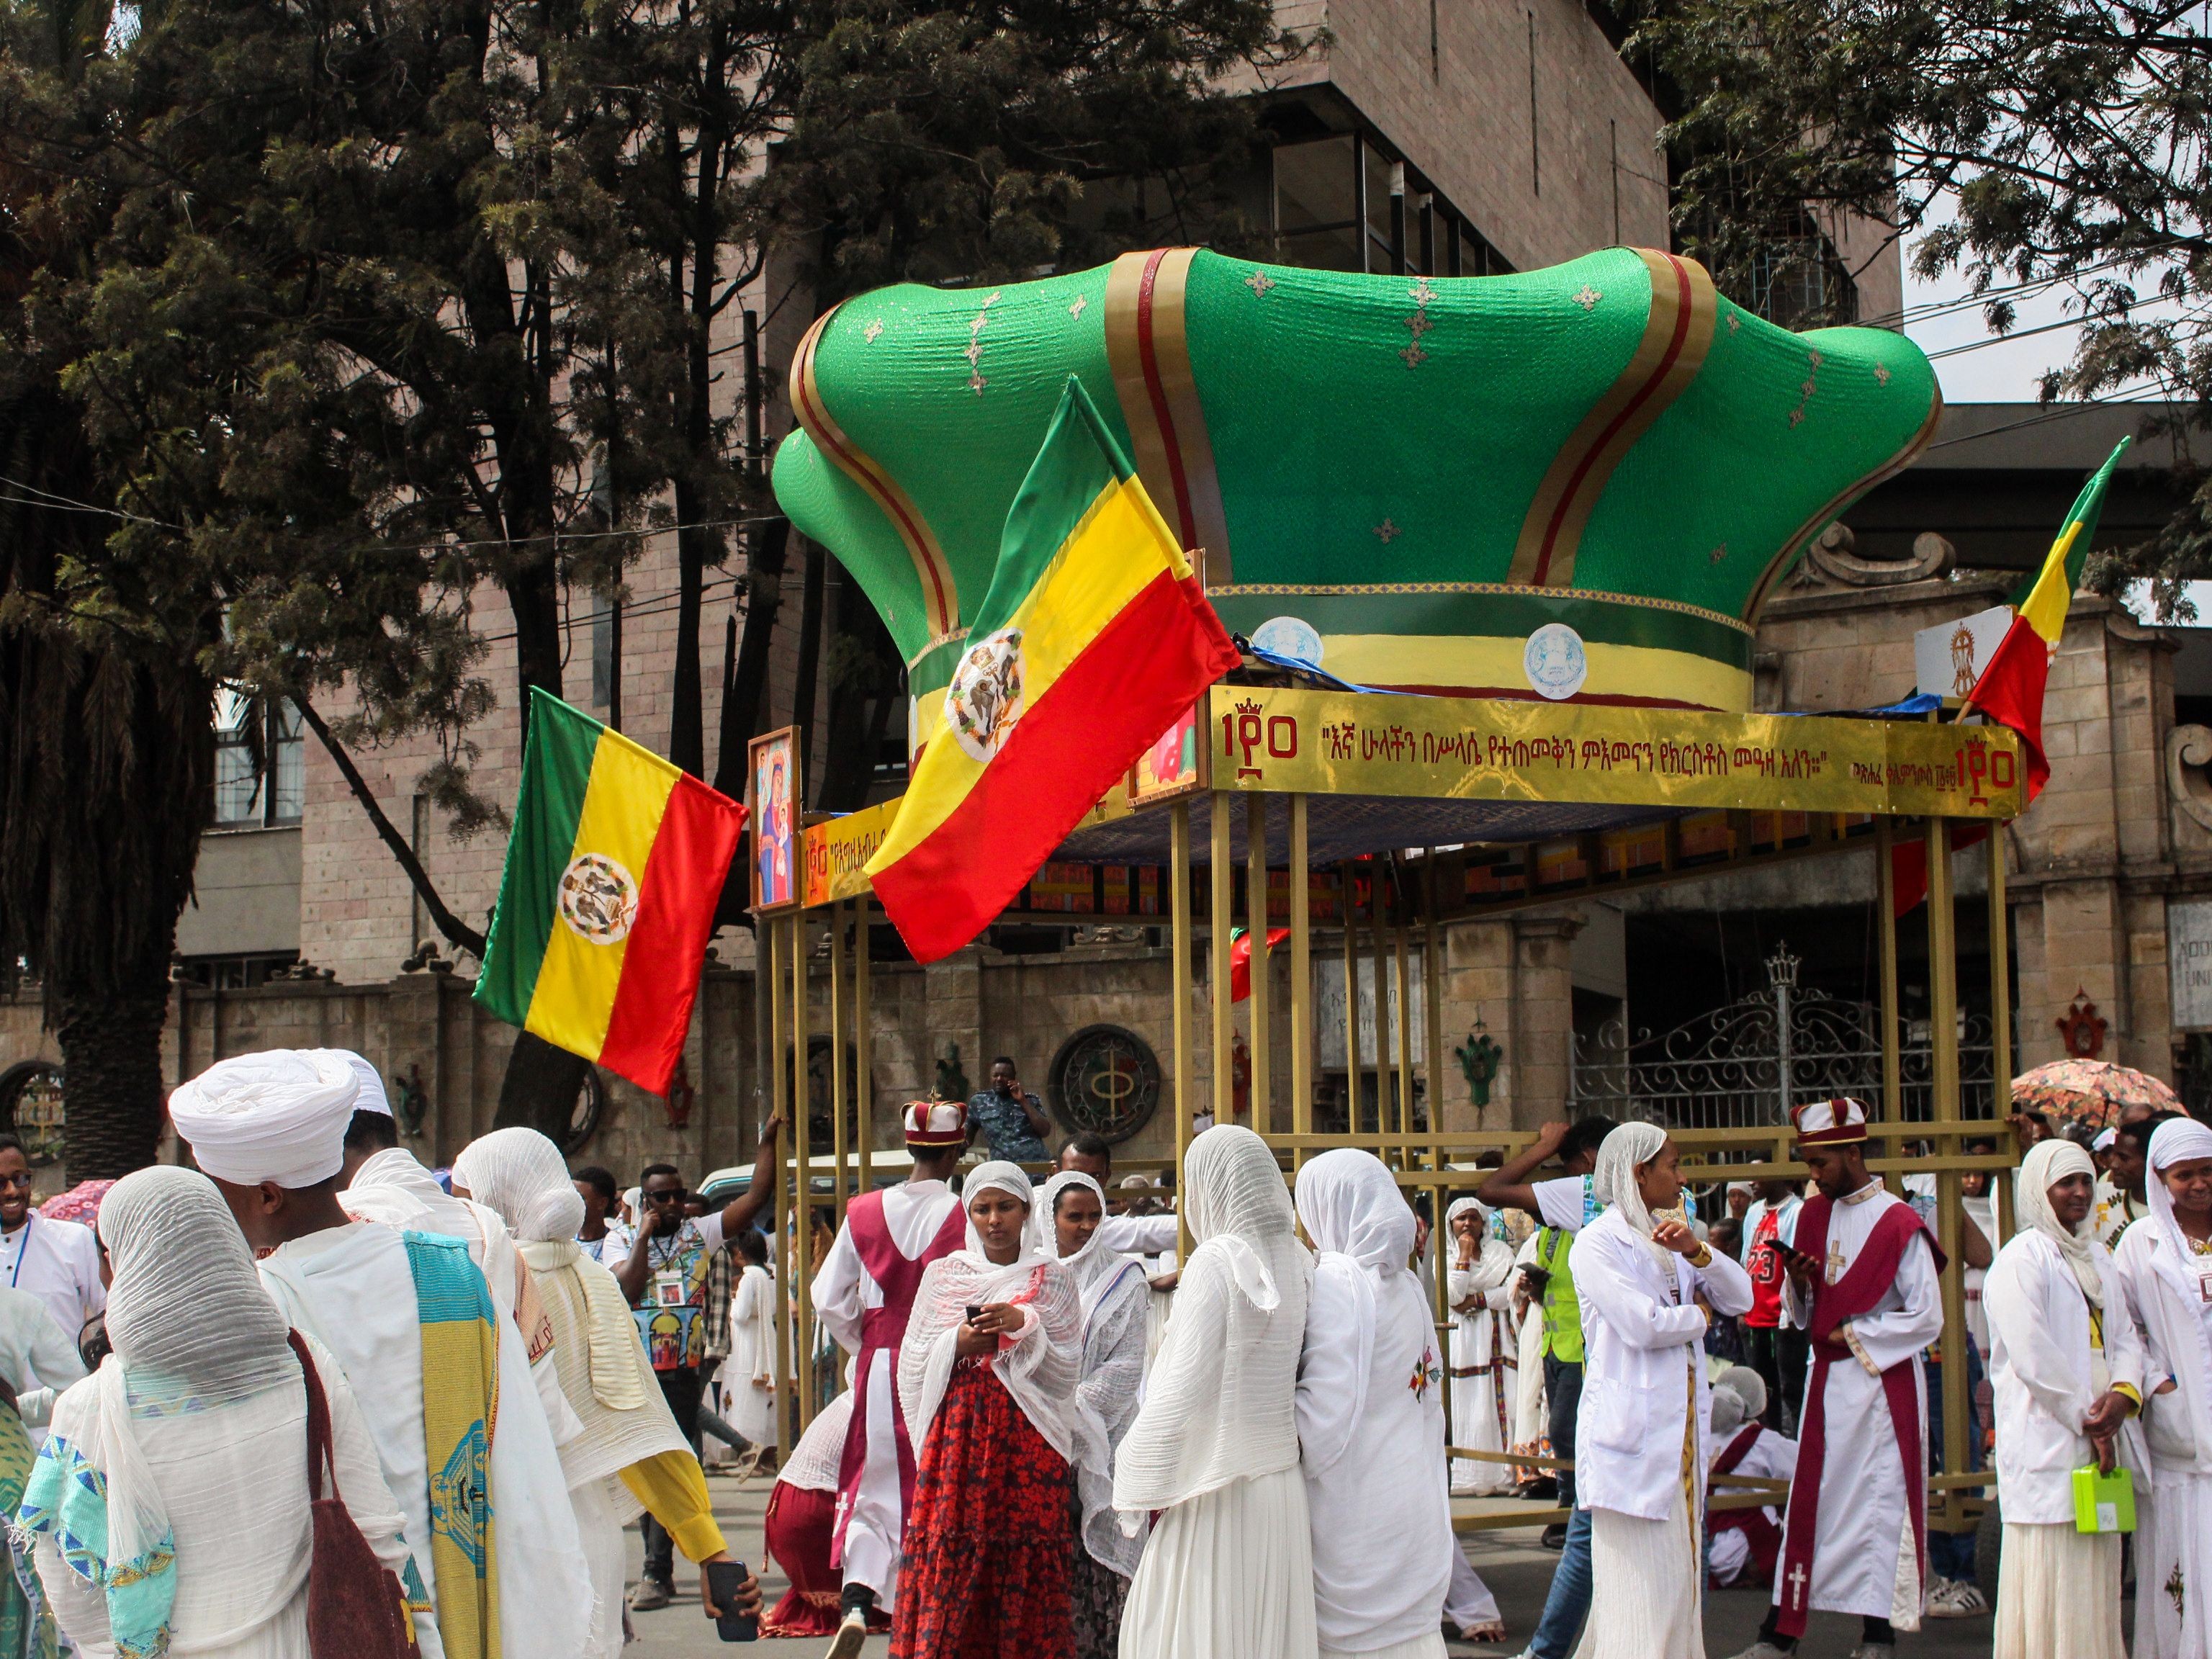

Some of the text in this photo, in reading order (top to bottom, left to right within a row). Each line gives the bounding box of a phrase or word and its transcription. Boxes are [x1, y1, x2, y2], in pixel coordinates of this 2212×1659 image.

[1362, 724, 1416, 762] ሁላችን
[1423, 732, 1482, 765] በሥላሴ
[1488, 734, 1575, 769] የተጠመቅን
[1581, 737, 1653, 772] ምእመናን
[1659, 741, 1728, 777] የክርስቶስ
[1733, 747, 1775, 778] መዓዛ
[1745, 1249, 1776, 1284] 23
